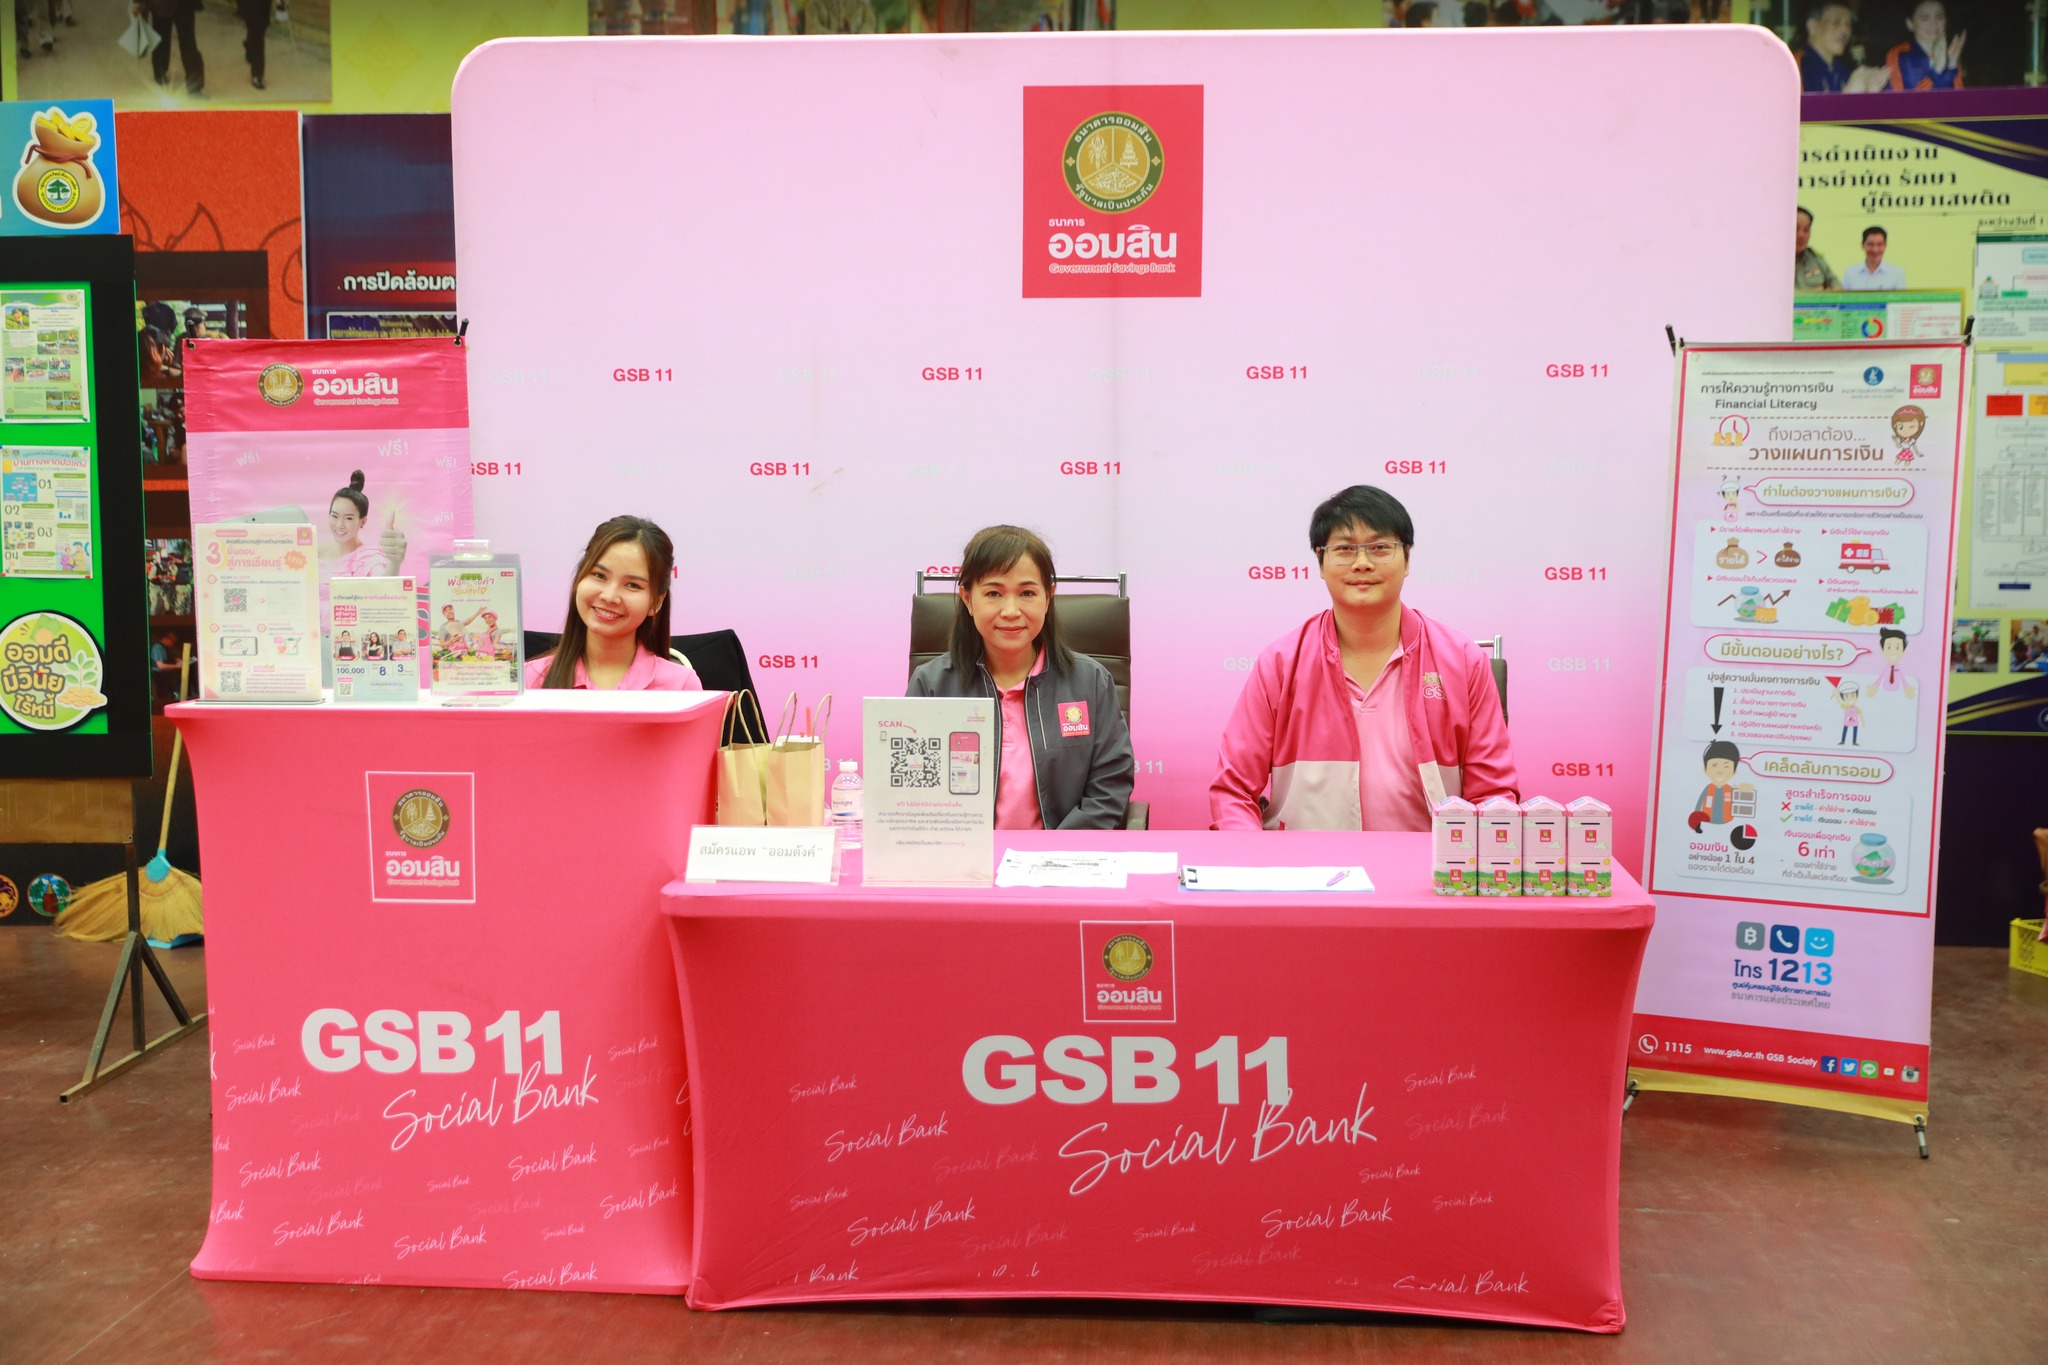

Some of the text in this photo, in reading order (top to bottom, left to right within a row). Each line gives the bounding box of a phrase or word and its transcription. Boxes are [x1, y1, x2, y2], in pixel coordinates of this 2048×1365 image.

[1074, 115, 1152, 144] ธนาคารออมสิน
[1801, 144, 1938, 162] ารดำเนินงาน
[1900, 168, 1957, 185] รักษา
[1861, 189, 2012, 214] ผู้ติดยาเสพติด
[1048, 218, 1085, 227] ธนาคาร
[1048, 223, 1177, 259] ออมสิน
[1049, 263, 1176, 275] Government Savings Bank
[343, 269, 457, 291] การปิดล้อมต
[613, 368, 673, 381] GSB 11
[922, 367, 983, 381] GSB 11
[1247, 366, 1307, 379] GSB 11
[1546, 364, 1609, 378] GSB 11
[312, 372, 399, 396] ออมสิน
[1700, 380, 1834, 397] การให้ความรู้ทางการเงิน
[1715, 399, 1817, 411] Financial Literacy
[1768, 426, 1866, 443] ถึงเวลาต้อง...
[1749, 444, 1884, 462] วางแผนการเงิน
[504, 463, 522, 475] 11
[750, 462, 810, 476] GSB 11
[1060, 461, 1121, 475] GSB 11
[1385, 461, 1446, 475] GSB 11
[1763, 483, 1908, 499] ทำไมต้องวางแผนการเงิน?
[206, 541, 221, 565] 3
[1719, 553, 1746, 565] รายได้
[1248, 566, 1309, 580] GSB 11
[1545, 567, 1607, 581] GSB 11
[5, 634, 71, 664] ออมดี
[1721, 638, 1843, 661] มีขั้นตอนอย่างไร?
[397, 664, 404, 673] 3
[759, 655, 819, 668] GSB 11
[1548, 657, 1611, 671] GSB 11
[1, 664, 66, 693] มีวินัย
[336, 667, 365, 675] 100,000
[379, 666, 387, 676] 8
[1422, 684, 1445, 700] GS
[14, 692, 56, 719] ไร้หนี้
[878, 720, 902, 728] SCAN
[1146, 760, 1163, 773] 11
[1552, 763, 1614, 777] GSB 11
[1764, 757, 1881, 778] เคล็ดลับการออม
[1785, 787, 1871, 802] สูตรสำเร็จการออม
[1794, 803, 1813, 811] รายได้
[1794, 814, 1812, 822] รายได้
[699, 842, 756, 857] สมัครแอพ
[1689, 840, 1728, 853] ออมเงิน
[1798, 841, 1835, 859] 6 เท่า
[386, 855, 460, 877] ออมสิน
[1688, 851, 1755, 864] อย่างน้อย 1 ใน 4
[1793, 860, 1837, 872] ของค่าใช้จ่าย
[1688, 863, 1754, 876] ของรายได้ต่อเดือน
[1734, 958, 1832, 985] โทร 1213
[1096, 986, 1162, 1003] ออมสิน
[1731, 990, 1831, 1009] ธนาคารแห่งประเทศไทย
[301, 1008, 563, 1075] GSB 11
[1664, 1041, 1818, 1068] 1115 www.gsb.or.th GSB Society
[962, 1034, 1289, 1105] GSB 11
[1405, 1064, 1476, 1092] Social Bank
[225, 1076, 302, 1111] Social Bank
[789, 1074, 857, 1102] Social Bank
[383, 1077, 503, 1150] Social
[513, 1055, 599, 1124] Bank
[825, 1111, 949, 1162] Social Bank
[1058, 1082, 1377, 1195] Social Bank
[239, 1150, 321, 1187] Social Bank
[508, 1142, 597, 1181] Social Bank
[600, 1178, 678, 1219] Social Bank
[847, 1197, 975, 1247] Social Bank
[1261, 1198, 1393, 1238] Social Bank
[273, 1208, 364, 1246] Social Bank
[394, 1224, 487, 1260] Social Bank
[502, 1261, 598, 1290] Social Bank
[1475, 1269, 1529, 1295] Bank
